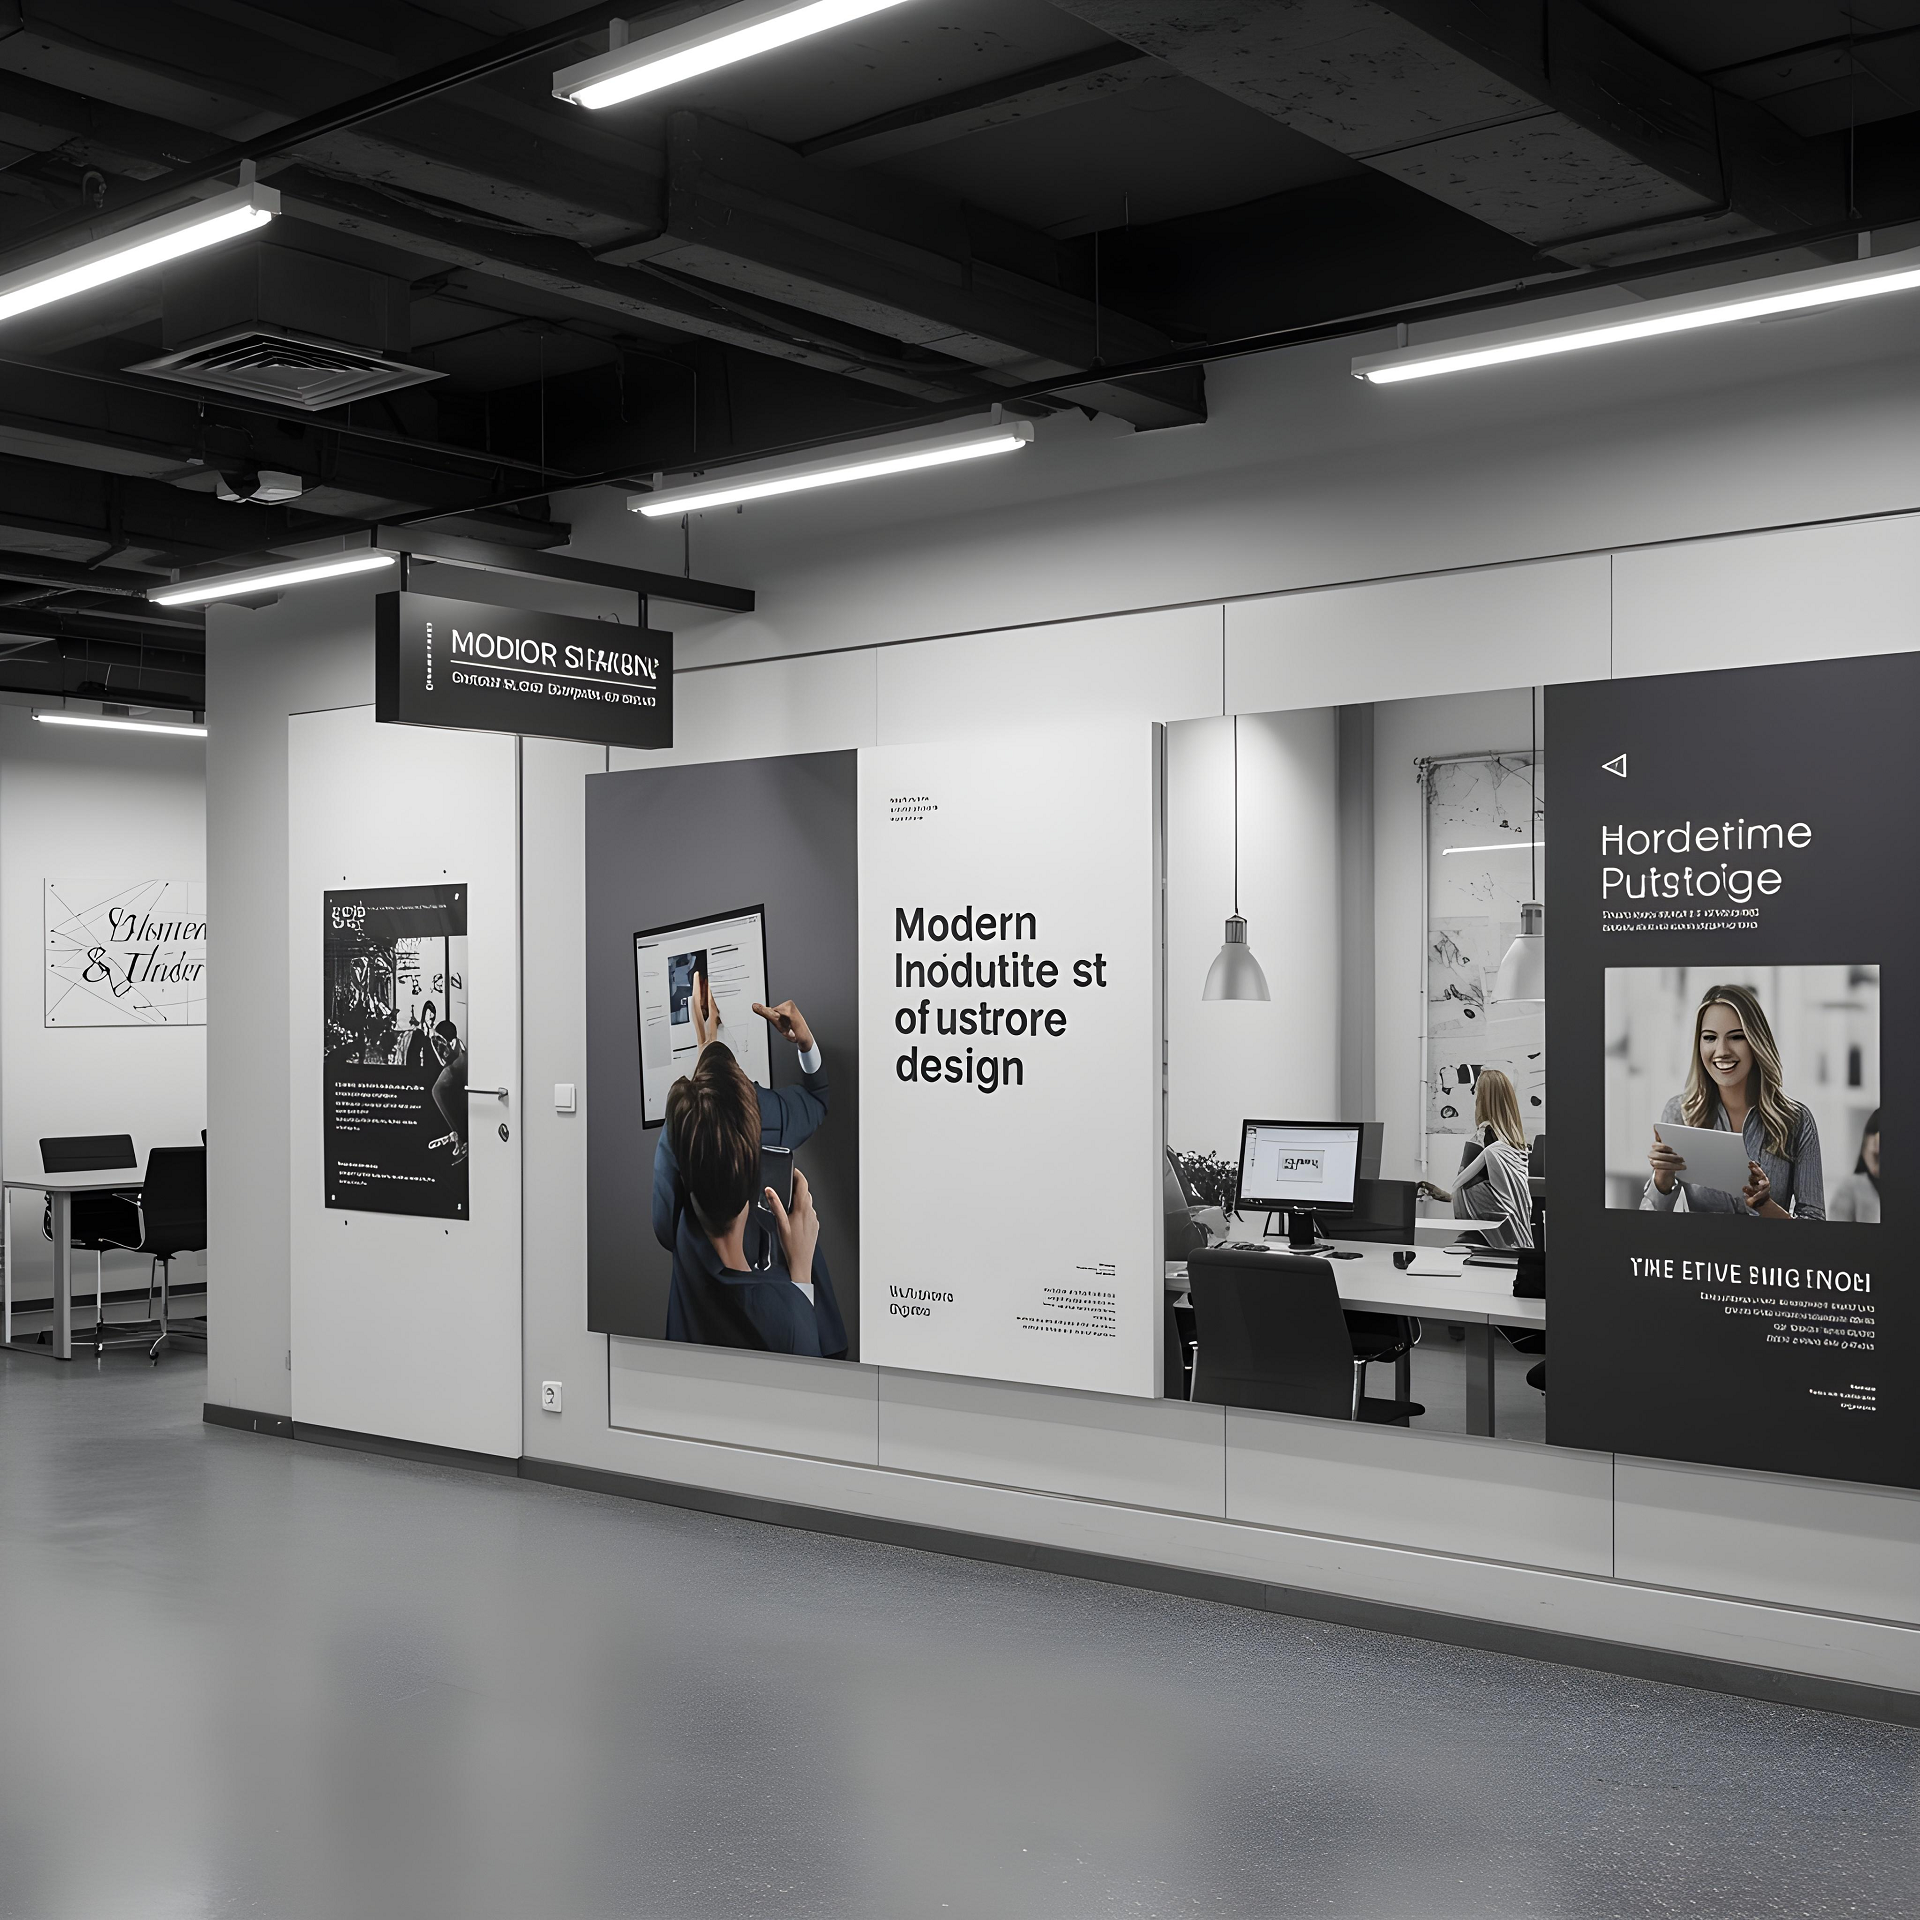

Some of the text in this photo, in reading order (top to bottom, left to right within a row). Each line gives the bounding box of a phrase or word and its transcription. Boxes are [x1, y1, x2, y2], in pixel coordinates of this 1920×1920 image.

[451, 629, 557, 668] MODIOR
[895, 905, 1037, 942] Modern
[1072, 953, 1107, 988] st
[896, 1046, 1024, 1094] design
